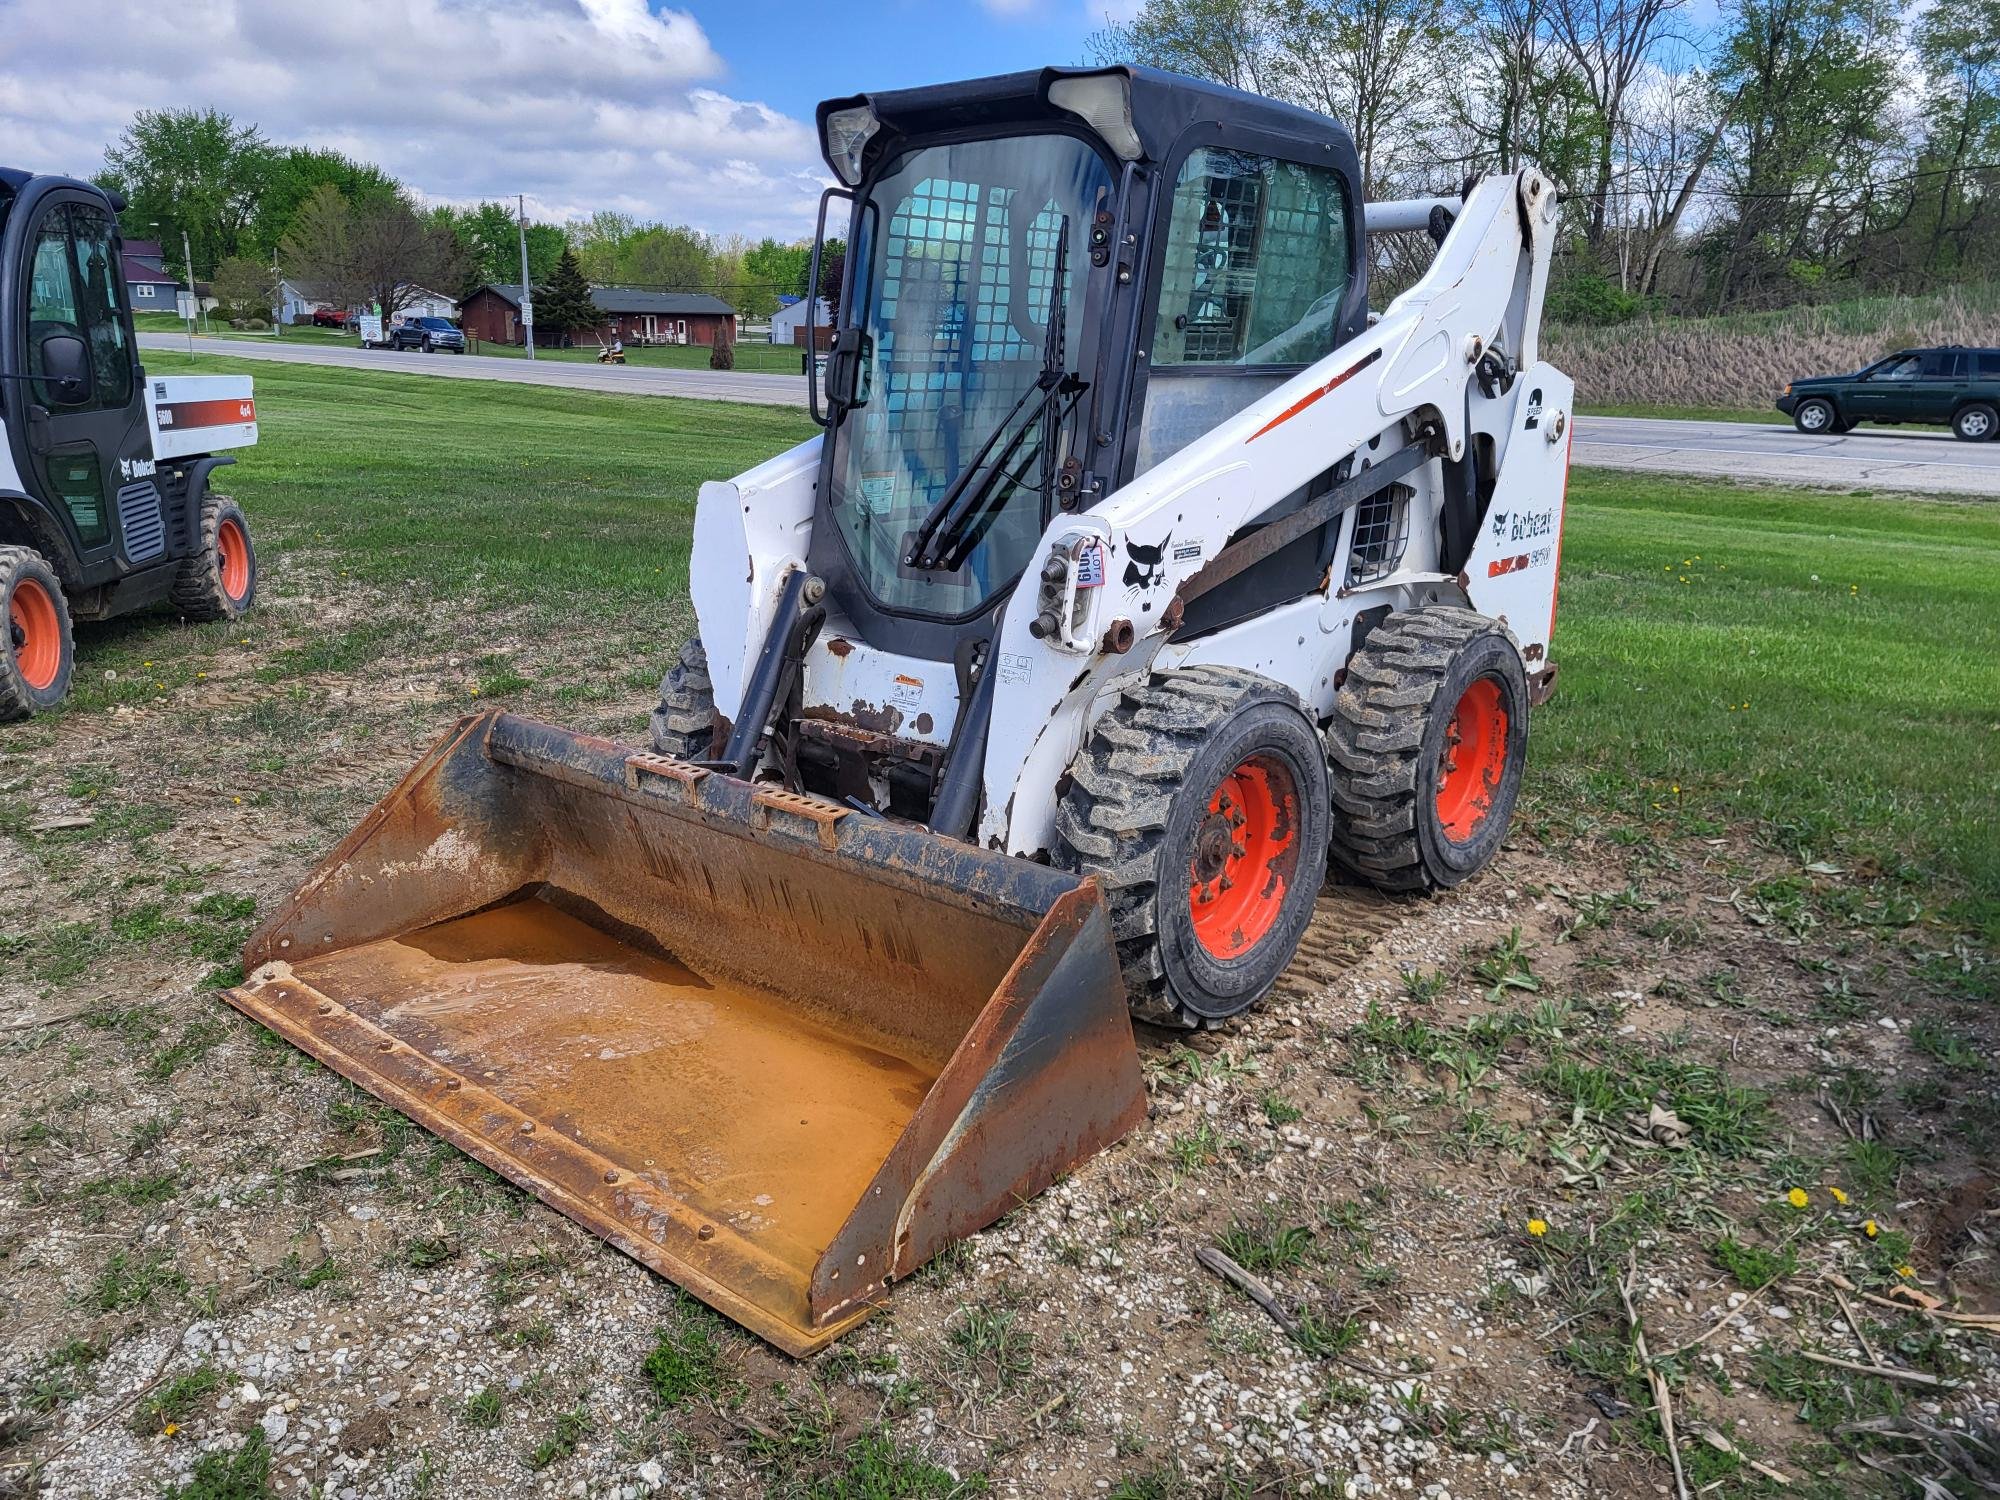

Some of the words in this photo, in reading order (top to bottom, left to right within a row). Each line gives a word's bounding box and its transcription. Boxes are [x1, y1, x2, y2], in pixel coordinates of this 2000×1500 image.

[157, 410, 173, 425] 5600
[1527, 407, 1542, 416] SPEED
[132, 459, 157, 478] Bobcat
[1511, 508, 1552, 541] Bobcat
[1078, 552, 1091, 581] 1019
[1092, 554, 1101, 570] LOT
